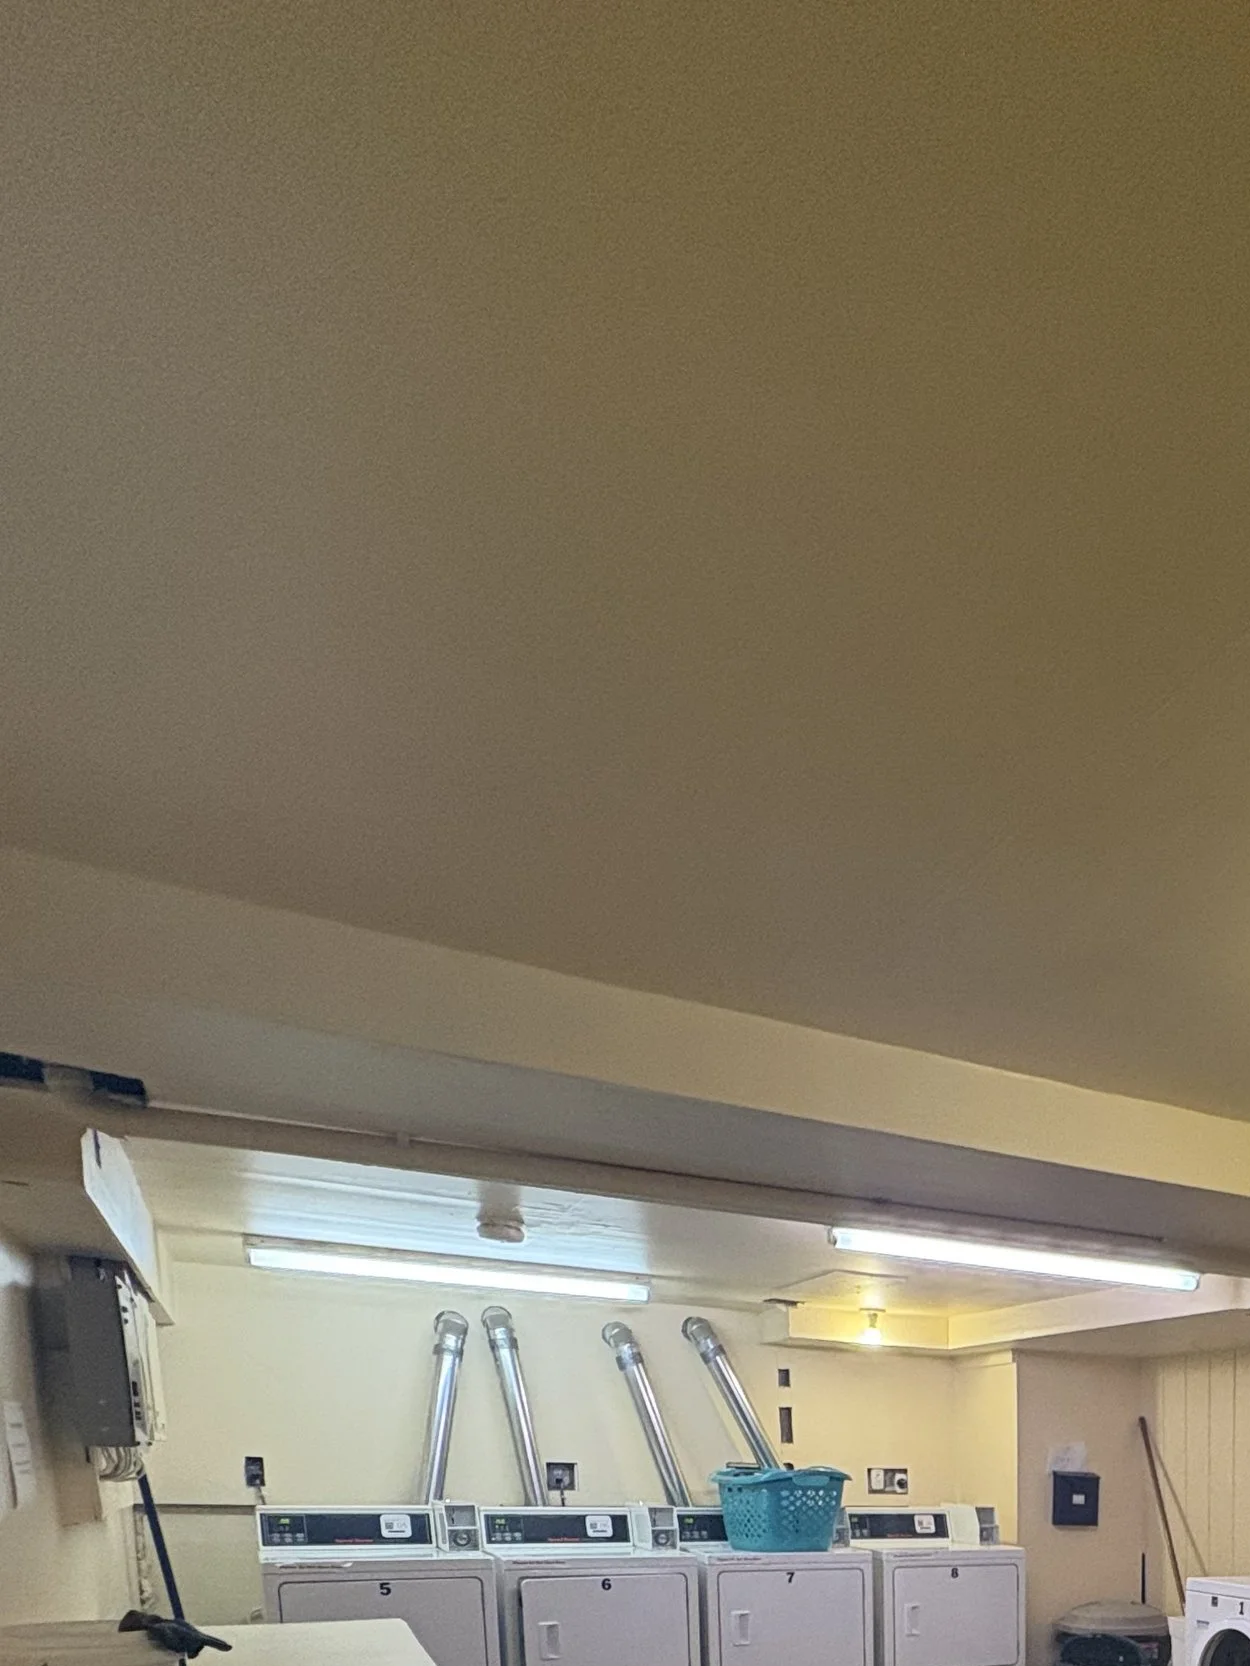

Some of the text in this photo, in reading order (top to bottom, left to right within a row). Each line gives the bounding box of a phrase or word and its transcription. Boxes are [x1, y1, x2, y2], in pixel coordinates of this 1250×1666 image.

[786, 1571, 795, 1583] 7
[379, 1582, 391, 1595] 5
[601, 1578, 611, 1590] 6
[1238, 1601, 1244, 1615] 1
